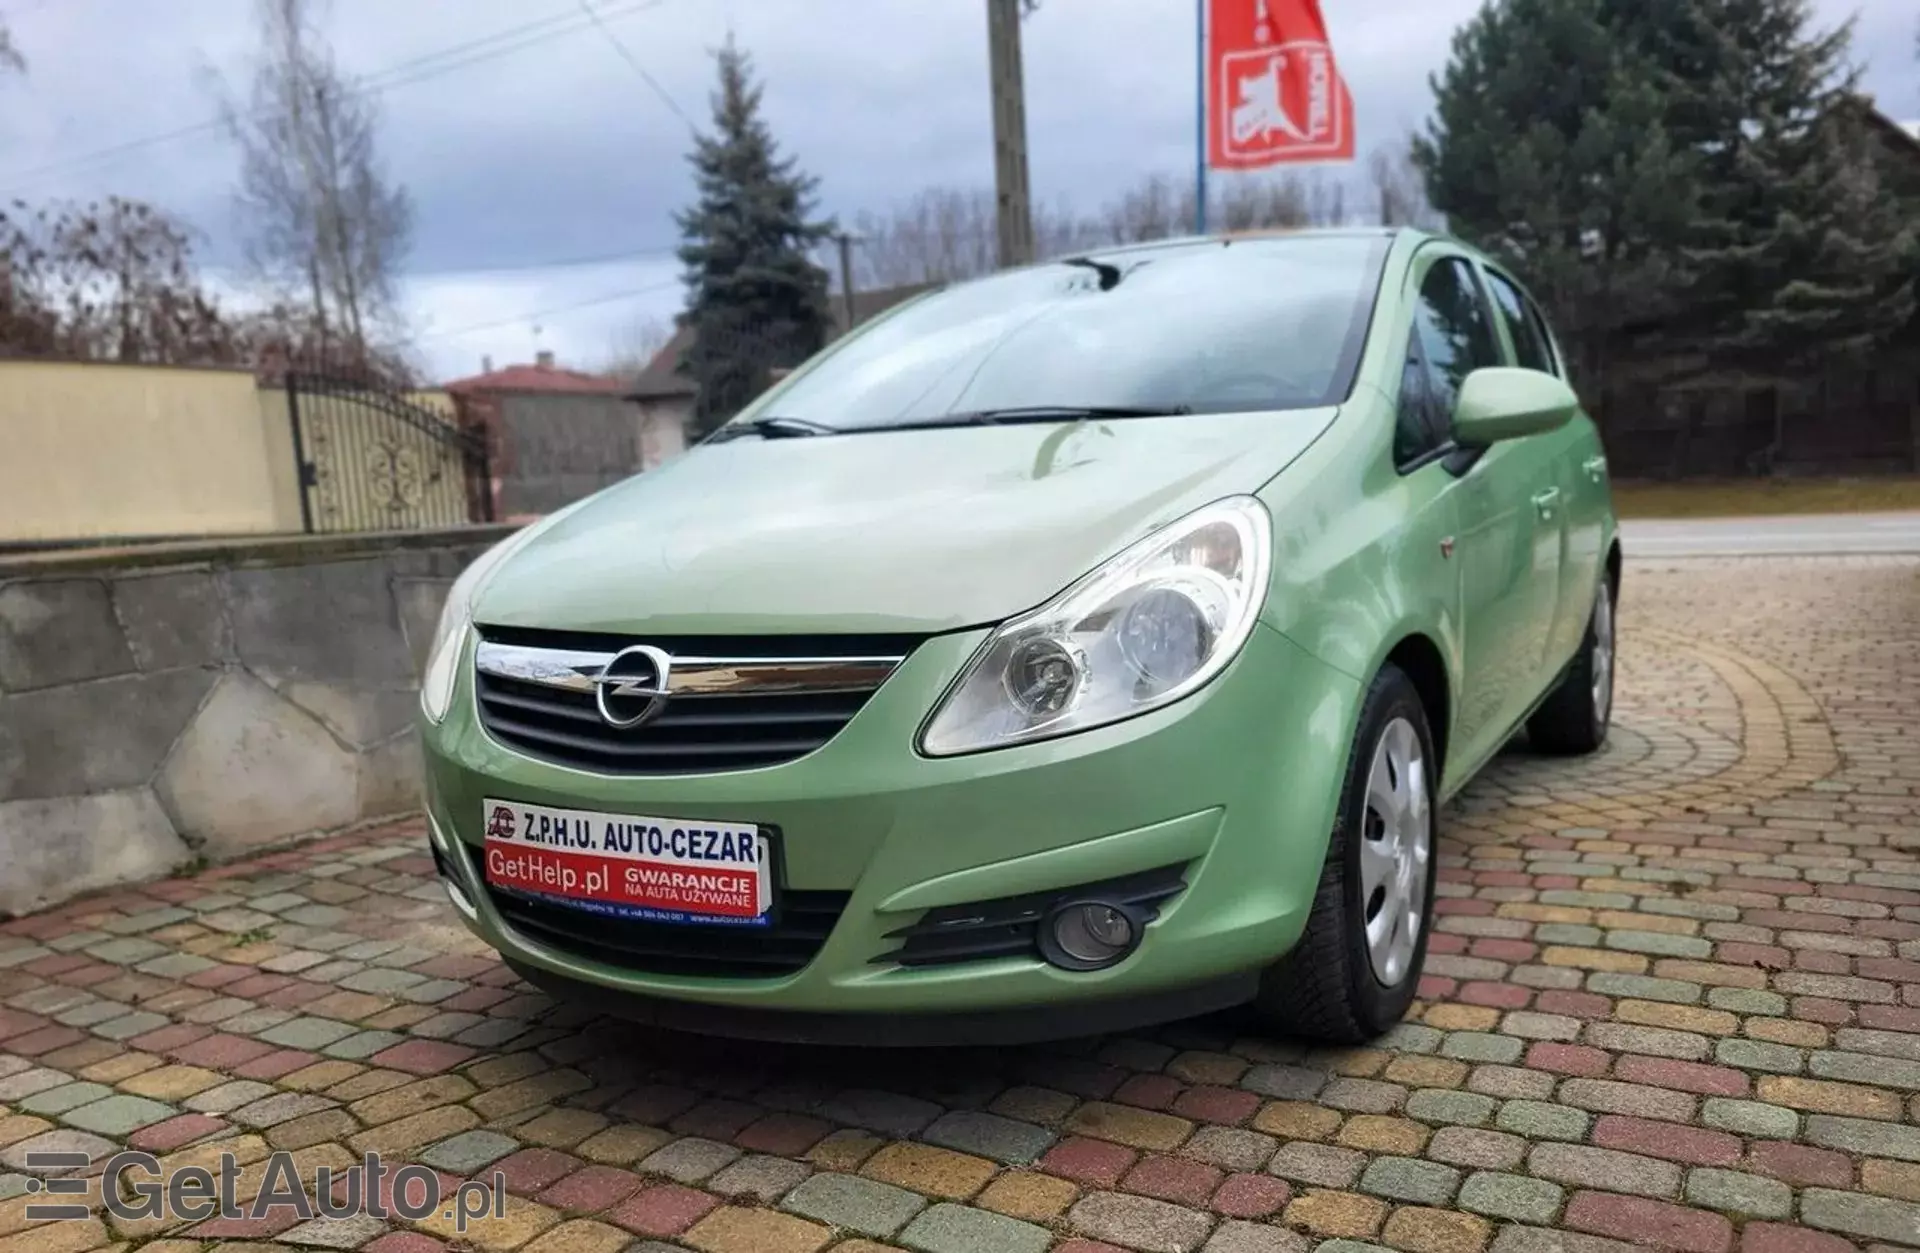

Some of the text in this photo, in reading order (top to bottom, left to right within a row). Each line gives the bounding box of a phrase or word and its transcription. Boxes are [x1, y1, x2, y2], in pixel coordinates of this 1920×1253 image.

[524, 812, 756, 863] Z.P.H.U. AUTO-CEZAR
[488, 848, 609, 895] GetHelp.pl
[624, 867, 751, 893] GWARANCJE
[624, 883, 752, 908] NA AUTA UŻYWANE
